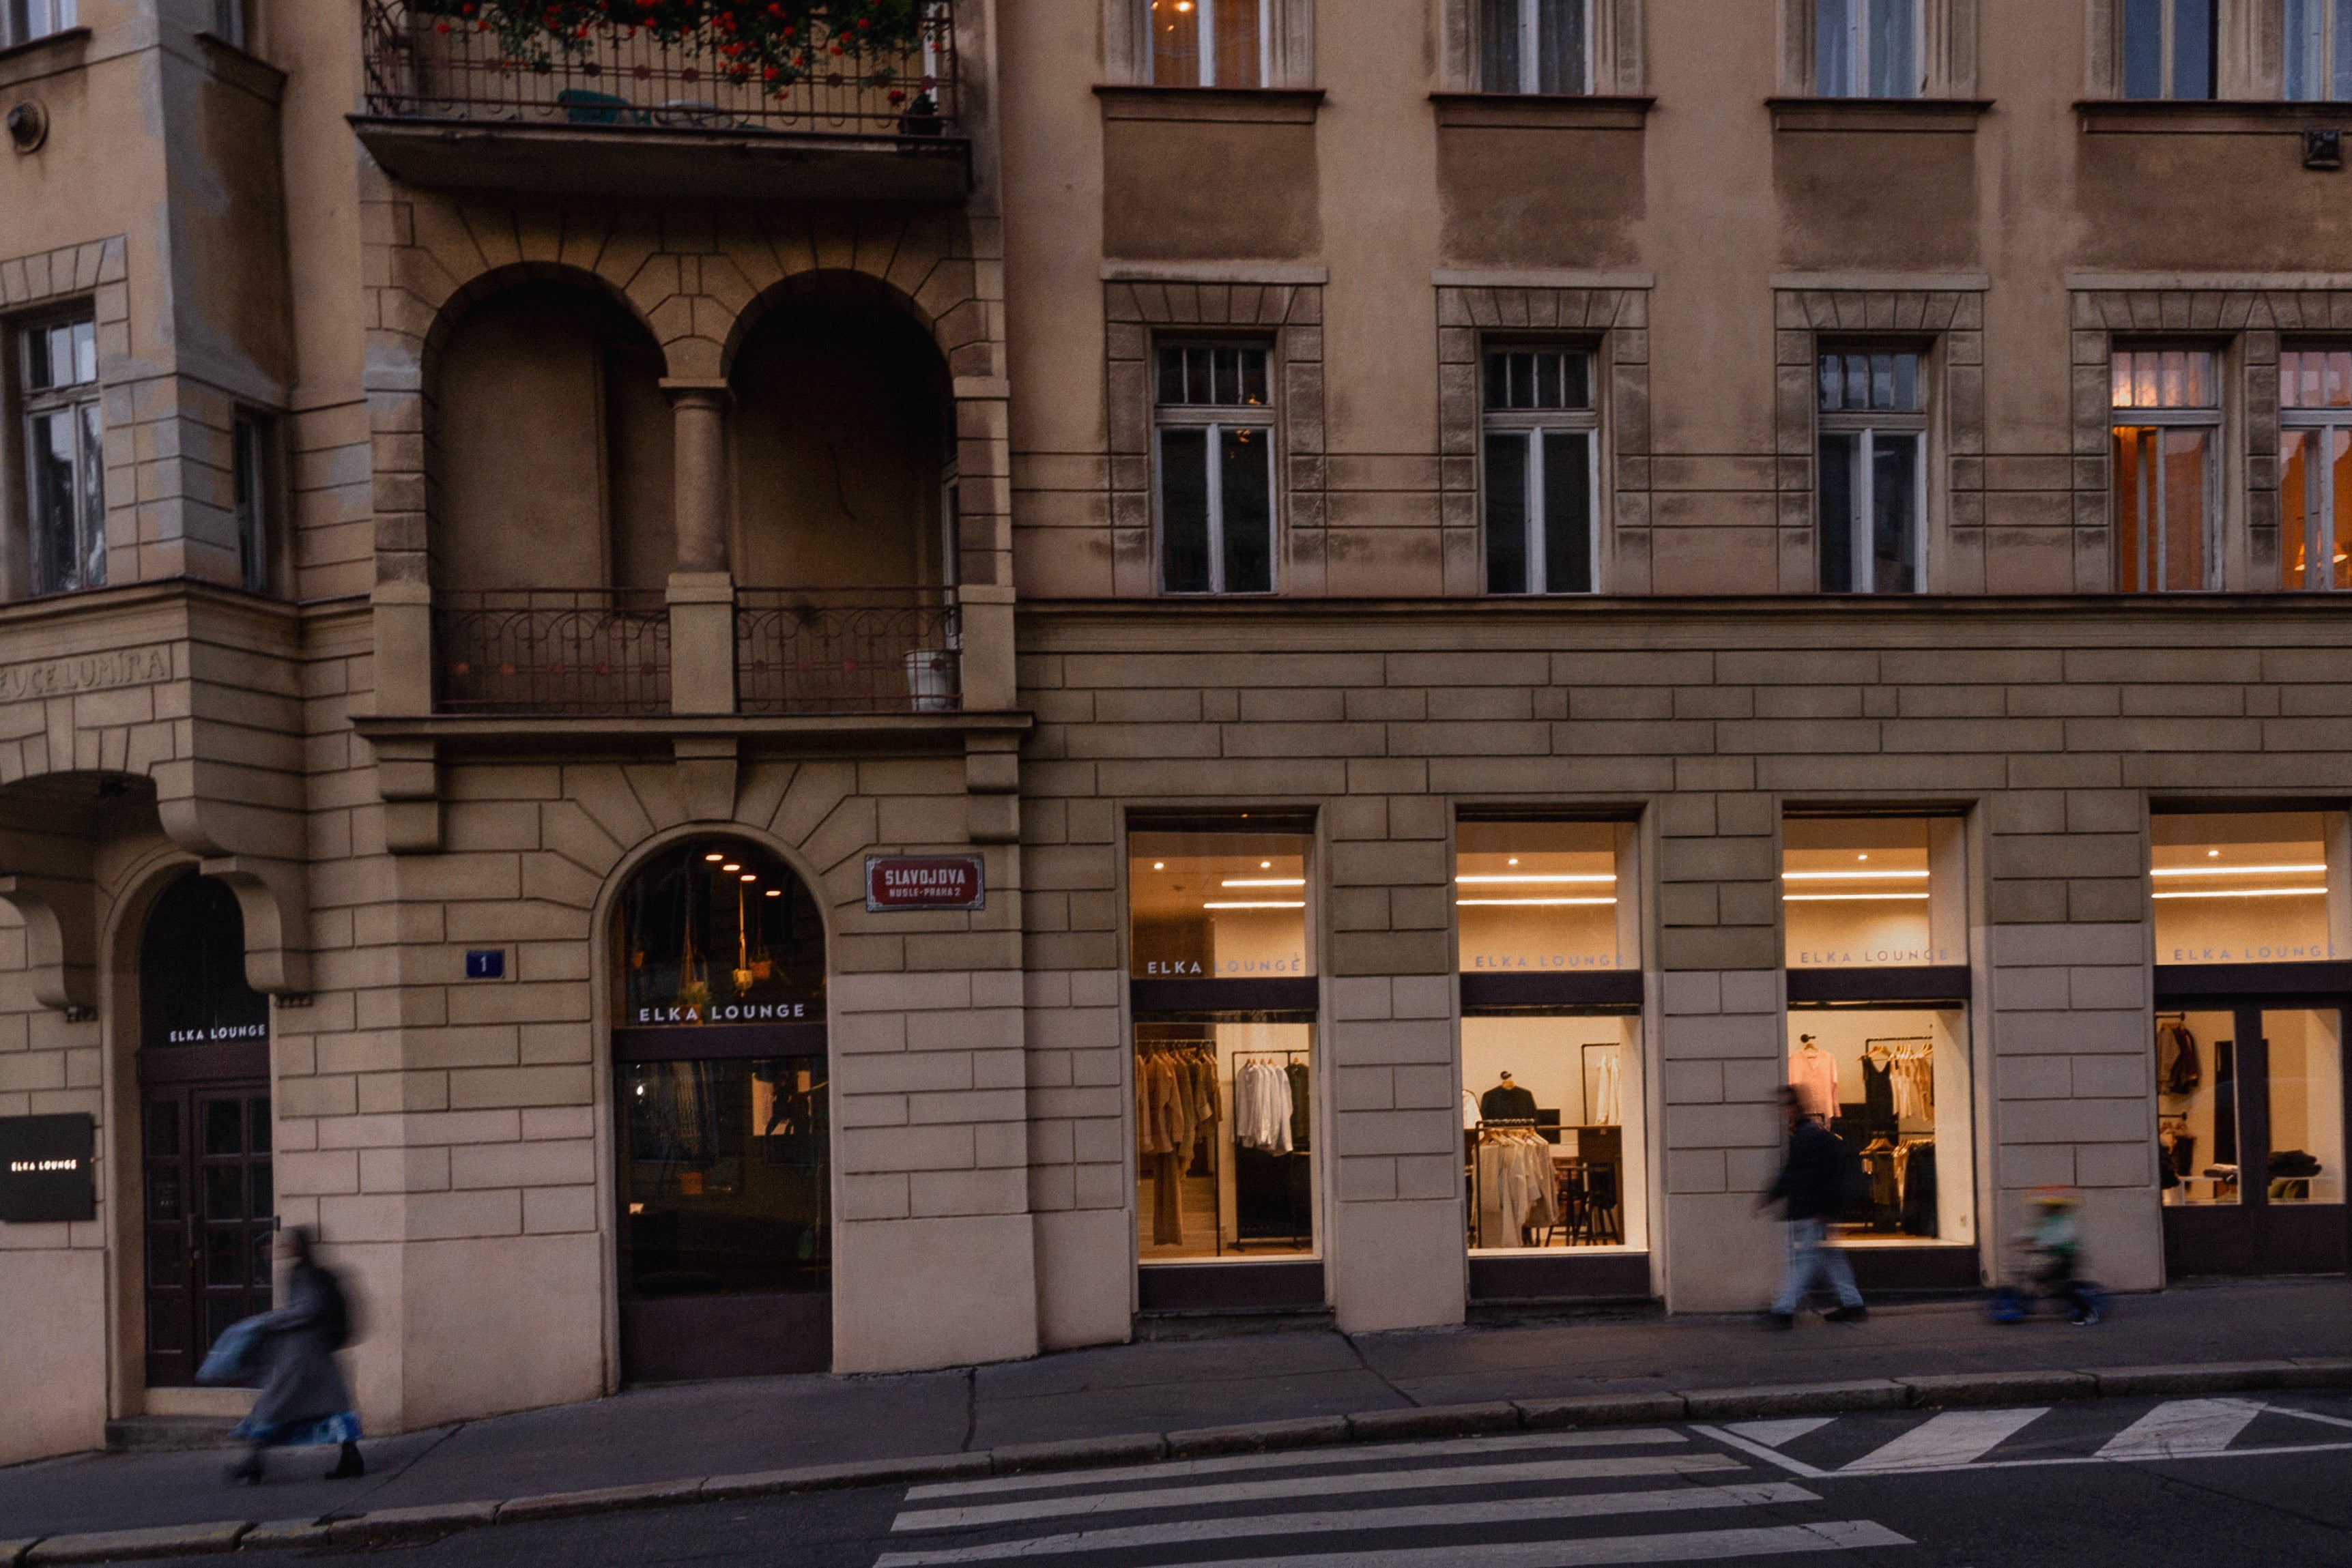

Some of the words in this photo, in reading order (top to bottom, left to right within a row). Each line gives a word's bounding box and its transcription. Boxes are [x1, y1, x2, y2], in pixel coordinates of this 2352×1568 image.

[885, 869, 966, 885] SLAVOJOVA
[954, 888, 961, 897] 2
[1801, 952, 1852, 963] ELKA
[1865, 949, 1948, 962] LOUNGE
[2174, 948, 2231, 960] ELKA
[2245, 945, 2336, 959] LOUNGE
[481, 956, 487, 972] 1
[1147, 961, 1202, 974] ELKA
[1214, 959, 1300, 972] LOUNGE
[1475, 955, 1527, 967] ELKA
[1540, 954, 1622, 967] LOUNGE
[640, 1008, 698, 1021] ELKA
[711, 1004, 804, 1020] LOUNGE
[170, 1030, 204, 1042] ELKA
[210, 1024, 265, 1039] LOUNGE
[12, 1161, 35, 1172] ELKA
[39, 1159, 76, 1170] LOUNGE
